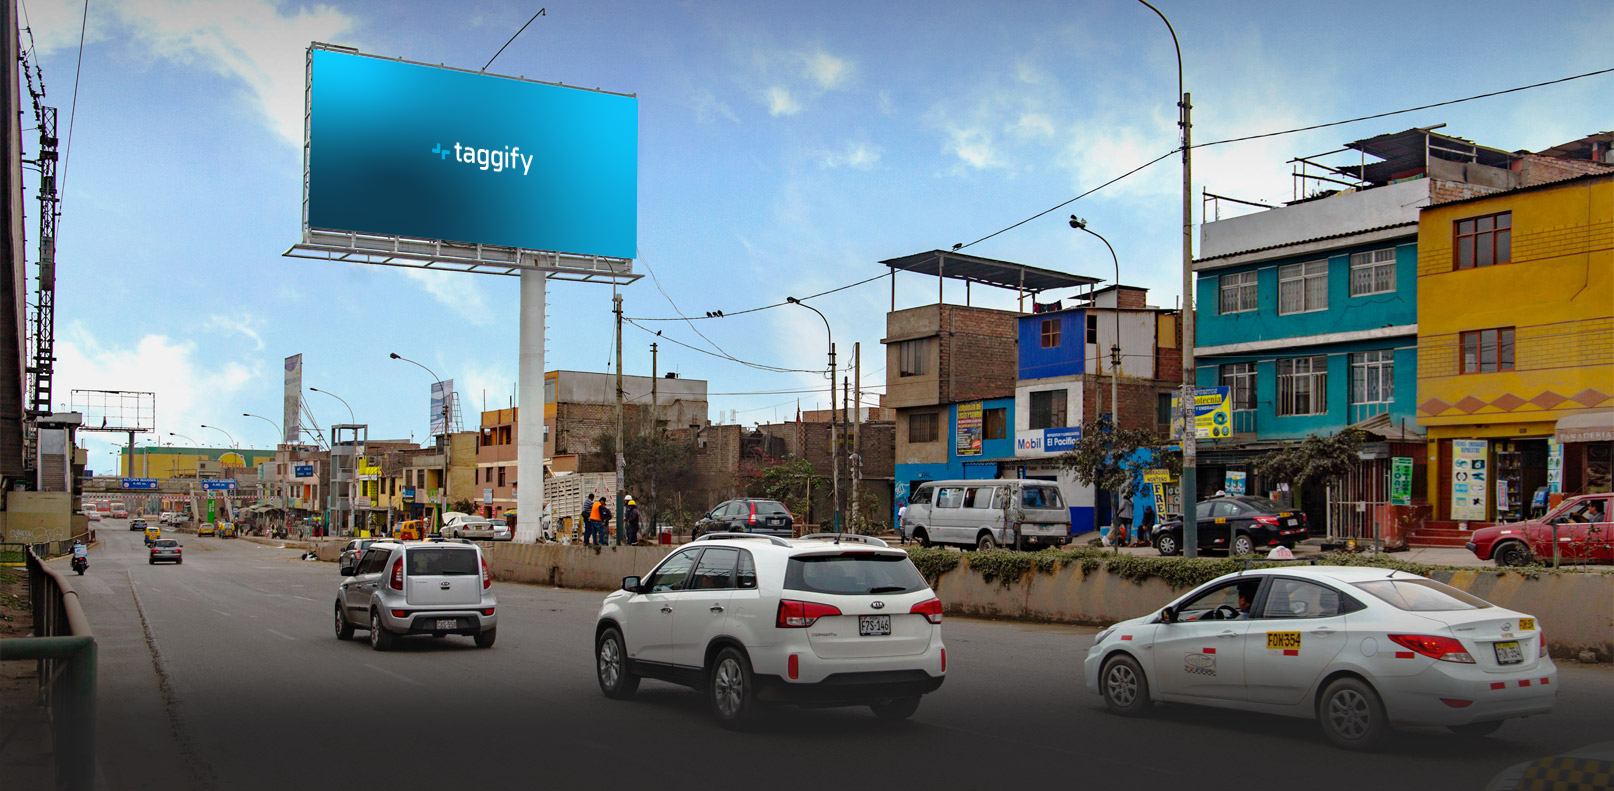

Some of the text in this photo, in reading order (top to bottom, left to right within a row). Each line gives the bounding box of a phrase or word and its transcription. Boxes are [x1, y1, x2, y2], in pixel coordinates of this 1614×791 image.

[454, 142, 533, 175] taggify
[1017, 438, 1042, 450] Mobil
[1047, 438, 1053, 447] El
[861, 621, 889, 631] F7S-146
